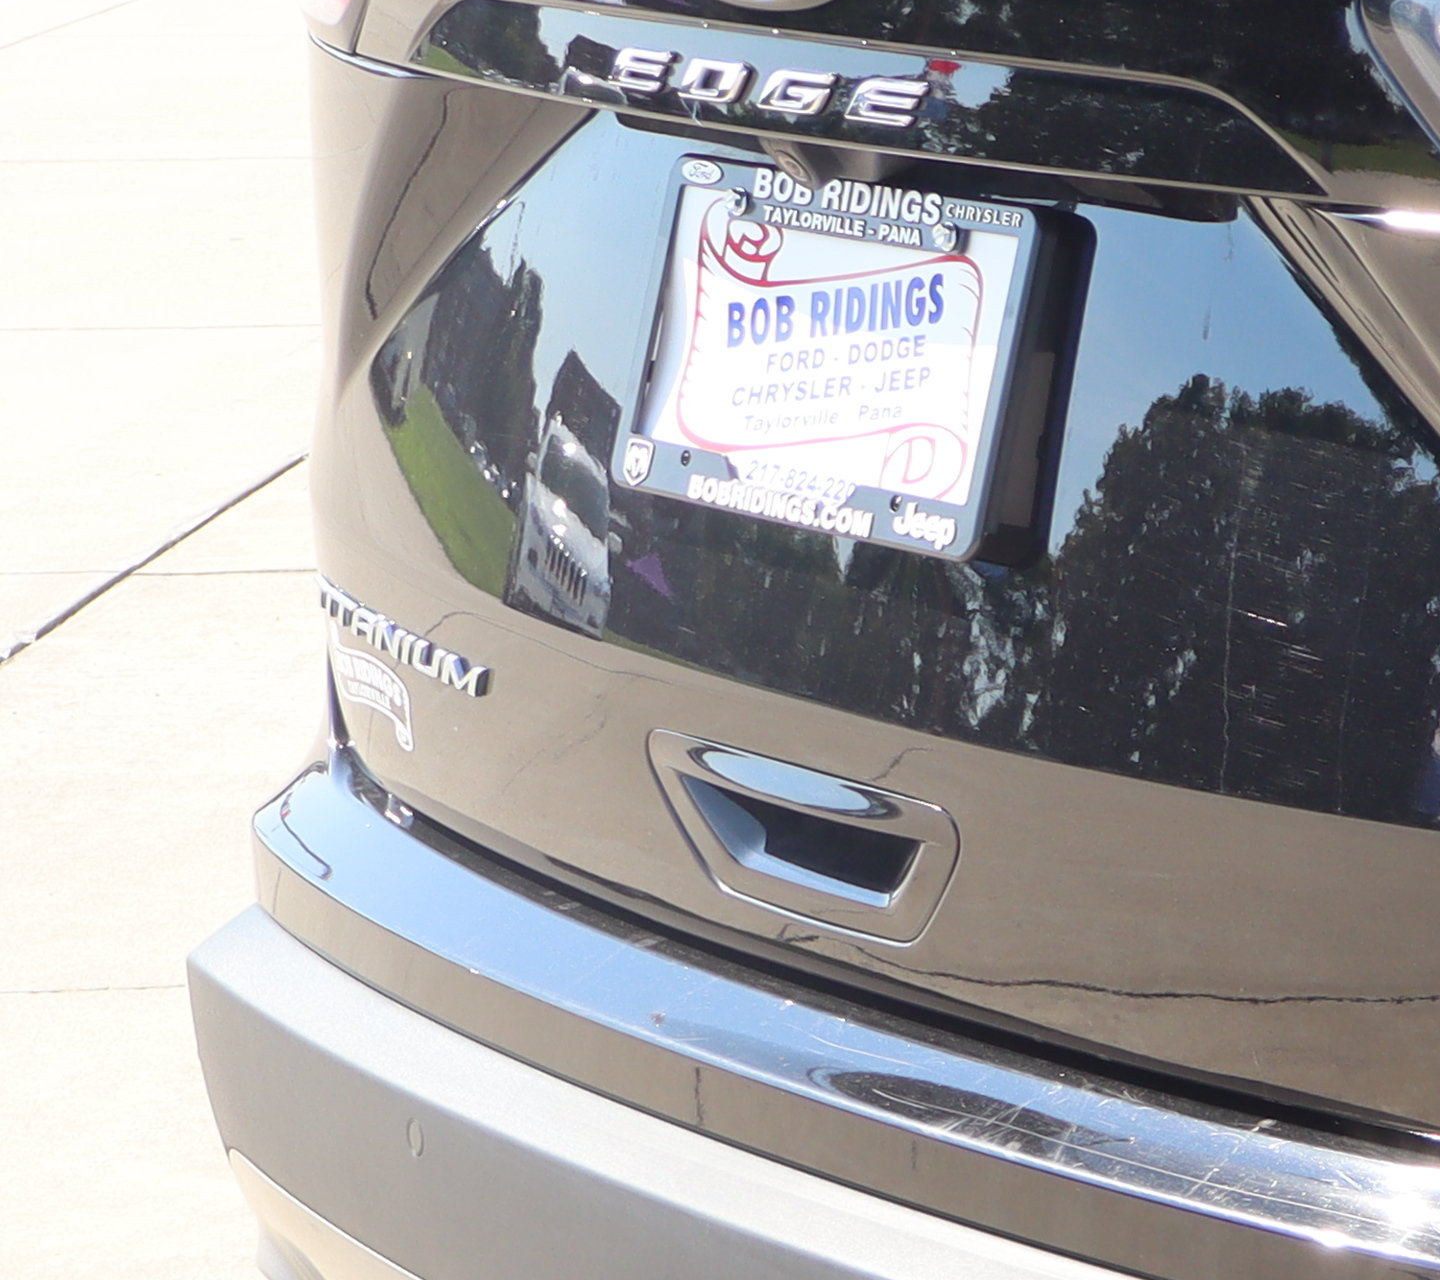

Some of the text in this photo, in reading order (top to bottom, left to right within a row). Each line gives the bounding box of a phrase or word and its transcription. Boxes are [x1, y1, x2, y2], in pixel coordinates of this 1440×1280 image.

[607, 47, 930, 127] EDGE
[753, 167, 942, 225] BOB RIDINGS
[946, 204, 1023, 228] CHRYSLER
[762, 204, 866, 238] TAYLORVILLE
[878, 224, 922, 247] PANA
[727, 273, 945, 348] BOB RIDINGS
[766, 348, 825, 373] FORD
[848, 335, 926, 365] DODGE
[732, 376, 852, 406] CHRYSLER
[874, 367, 930, 393] JEEP
[744, 405, 902, 435] Taylorville Pana
[687, 474, 874, 538] BOBRIDINGS.COM
[893, 501, 956, 549] Jeep
[314, 572, 490, 697] TITANIUM
